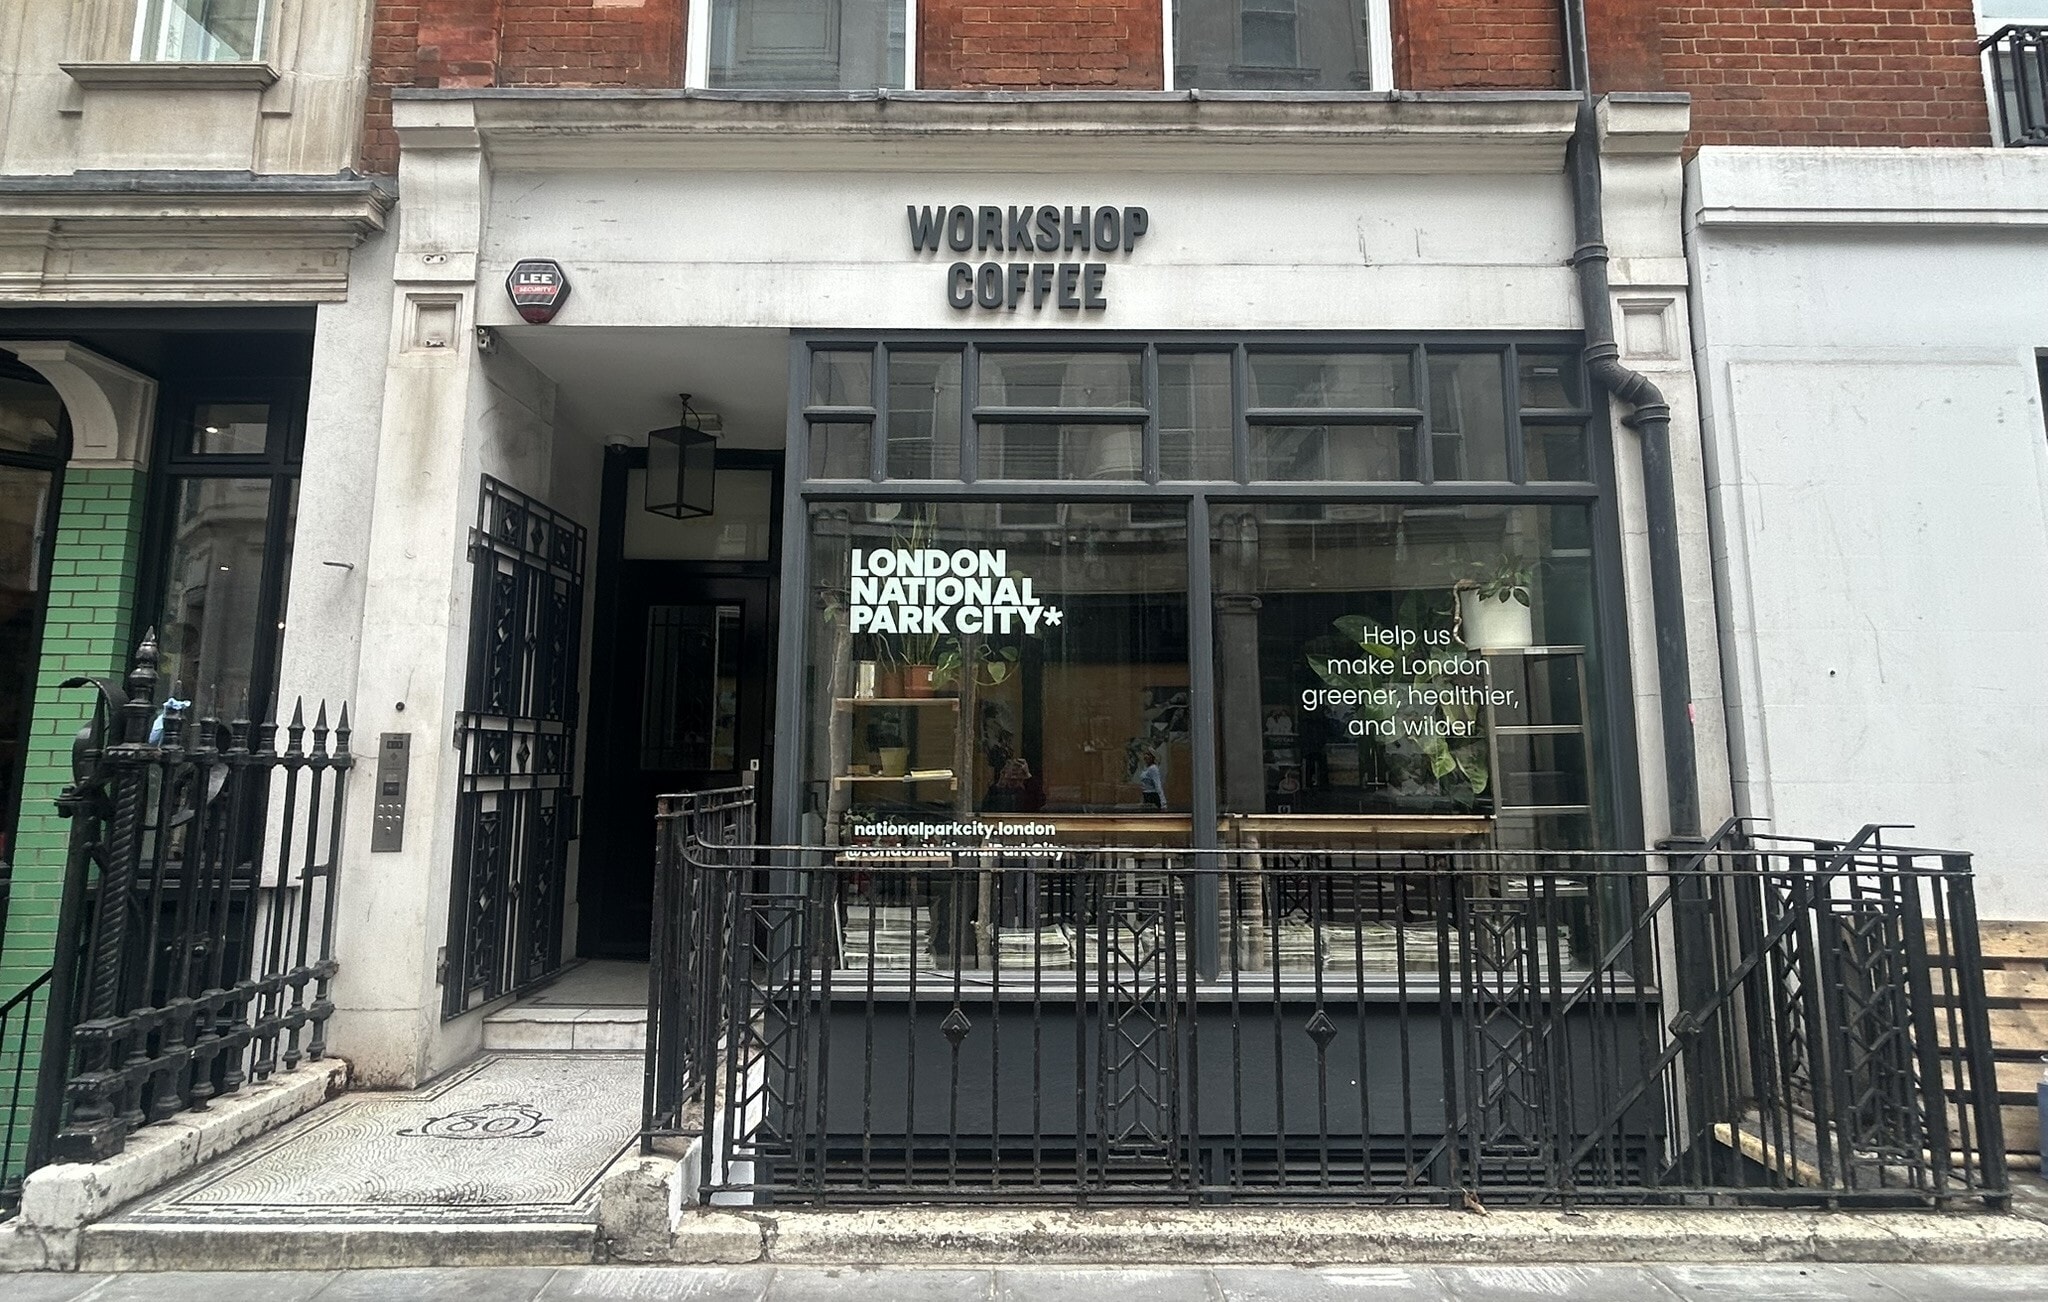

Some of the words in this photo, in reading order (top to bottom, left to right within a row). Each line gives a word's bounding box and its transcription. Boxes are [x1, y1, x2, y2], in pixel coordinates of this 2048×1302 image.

[907, 205, 1149, 254] WORKSHOP
[520, 273, 553, 284] LEE
[947, 262, 1107, 310] COFFEE
[851, 548, 1006, 577] LONDON
[851, 577, 1040, 605] NATIONAL
[850, 605, 950, 634] PARK
[1363, 625, 1416, 650] Help
[1424, 629, 1451, 645] us
[1327, 655, 1395, 675] make
[1402, 655, 1490, 675] London
[1301, 688, 1402, 711] greener,
[1408, 685, 1519, 709] healthier,
[1348, 715, 1396, 736] and
[1402, 715, 1476, 736] wilder
[854, 821, 1056, 839] nationalparkcity.london
